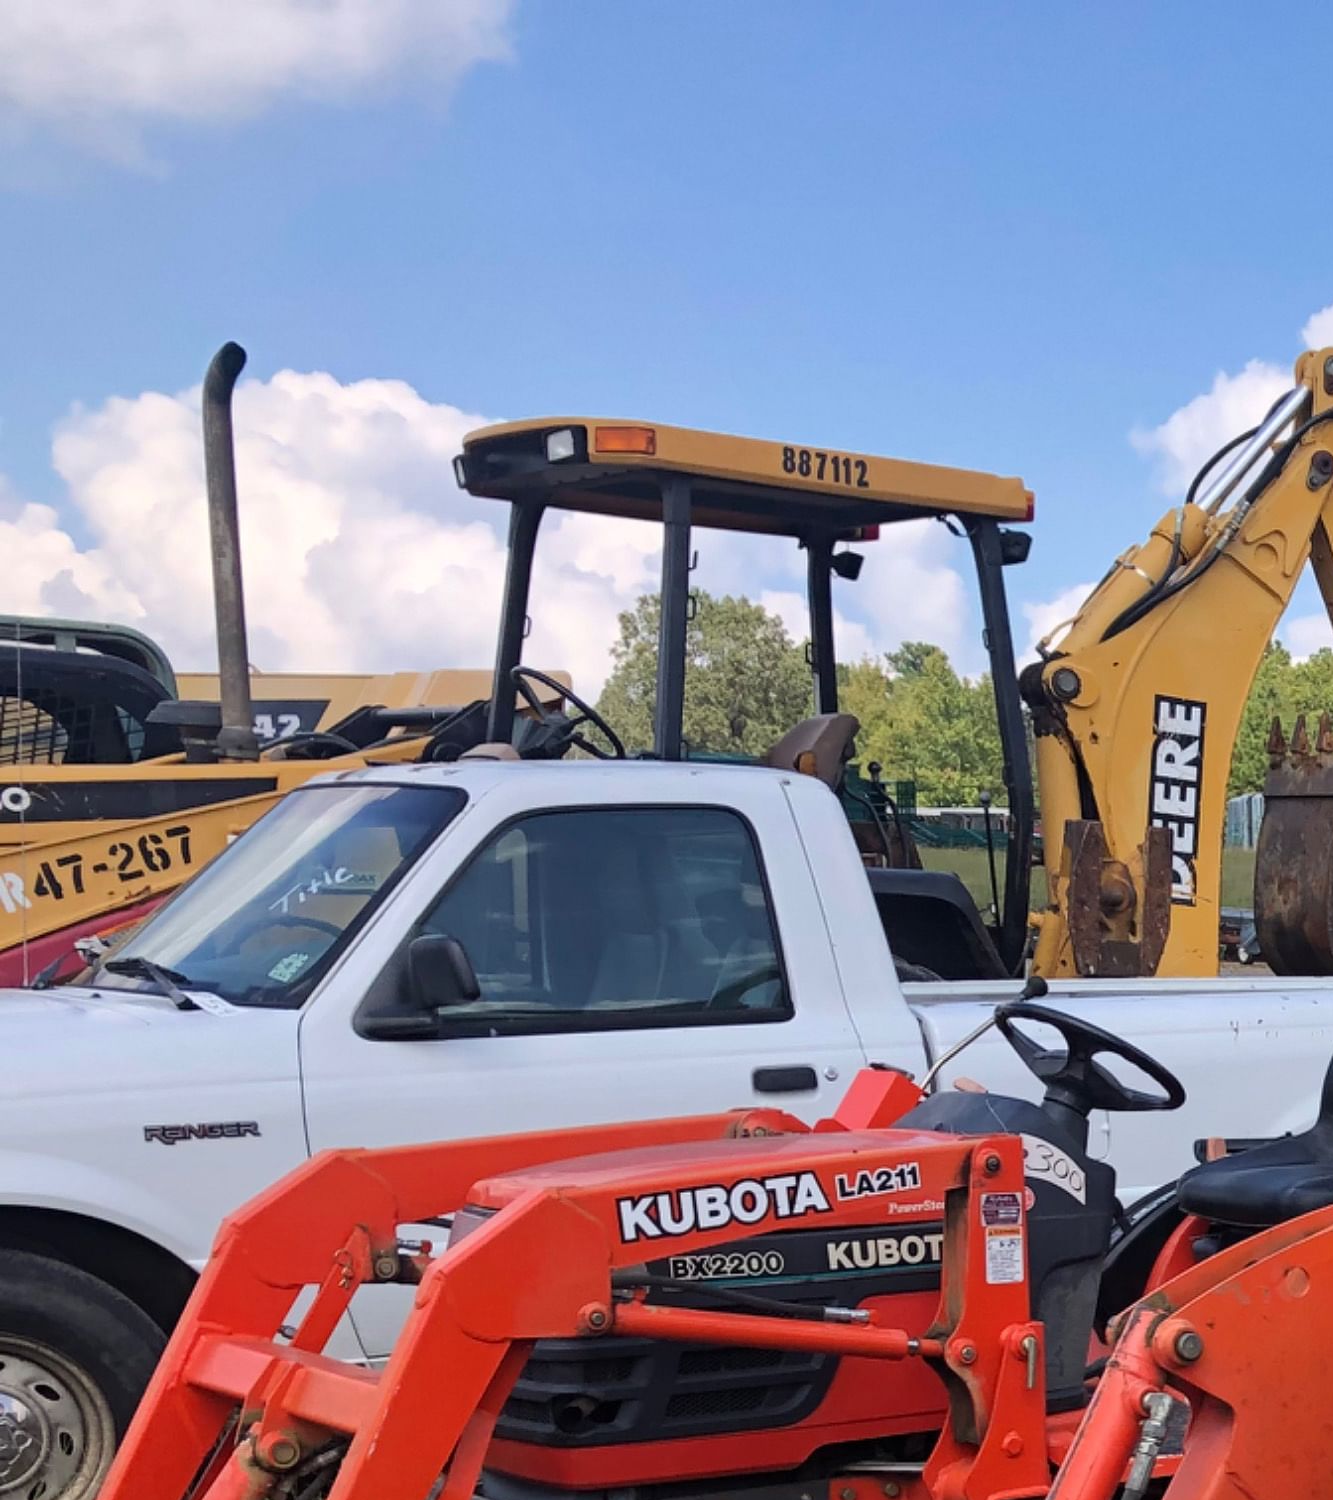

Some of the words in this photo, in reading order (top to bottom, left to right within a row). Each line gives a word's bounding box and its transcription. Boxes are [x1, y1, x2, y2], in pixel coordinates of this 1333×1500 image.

[783, 446, 869, 488] 887112
[34, 825, 191, 900] 47-267
[1024, 1143, 1083, 1192] 300
[619, 1171, 832, 1242] KUBOTA
[836, 1163, 920, 1199] LA211
[671, 1253, 784, 1279] BX2200
[827, 1233, 944, 1270] KUBOT
